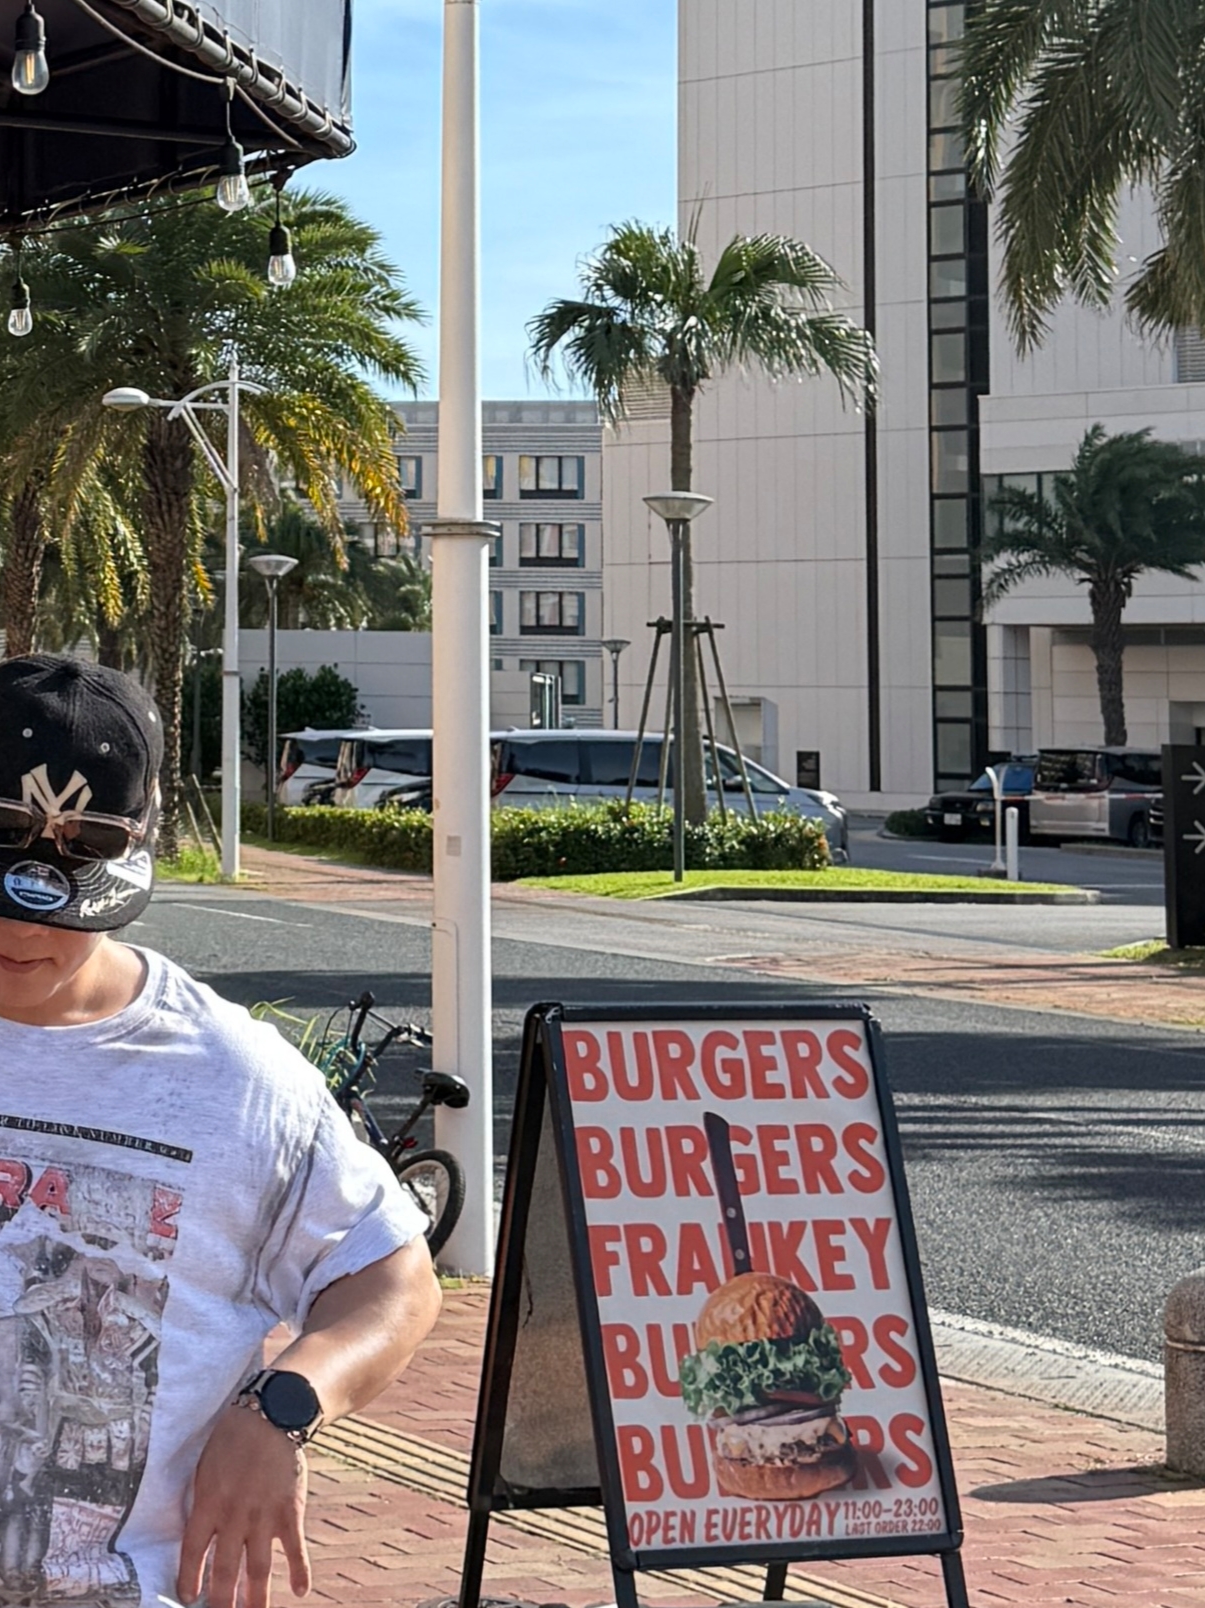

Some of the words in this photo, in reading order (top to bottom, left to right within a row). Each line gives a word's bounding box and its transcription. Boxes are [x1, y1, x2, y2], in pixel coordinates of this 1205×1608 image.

[562, 1028, 870, 1102] BURGERS
[575, 1122, 886, 1200] BURGERS
[587, 1217, 892, 1297] FRANKEY
[601, 1314, 917, 1400] BURS
[616, 1413, 933, 1502] BURS
[629, 1509, 697, 1548] OPEN
[703, 1501, 841, 1542] EVERYDAY
[845, 1522, 872, 1537] LAST
[875, 1520, 909, 1535] ORDER
[911, 1518, 942, 1533] 22:00
